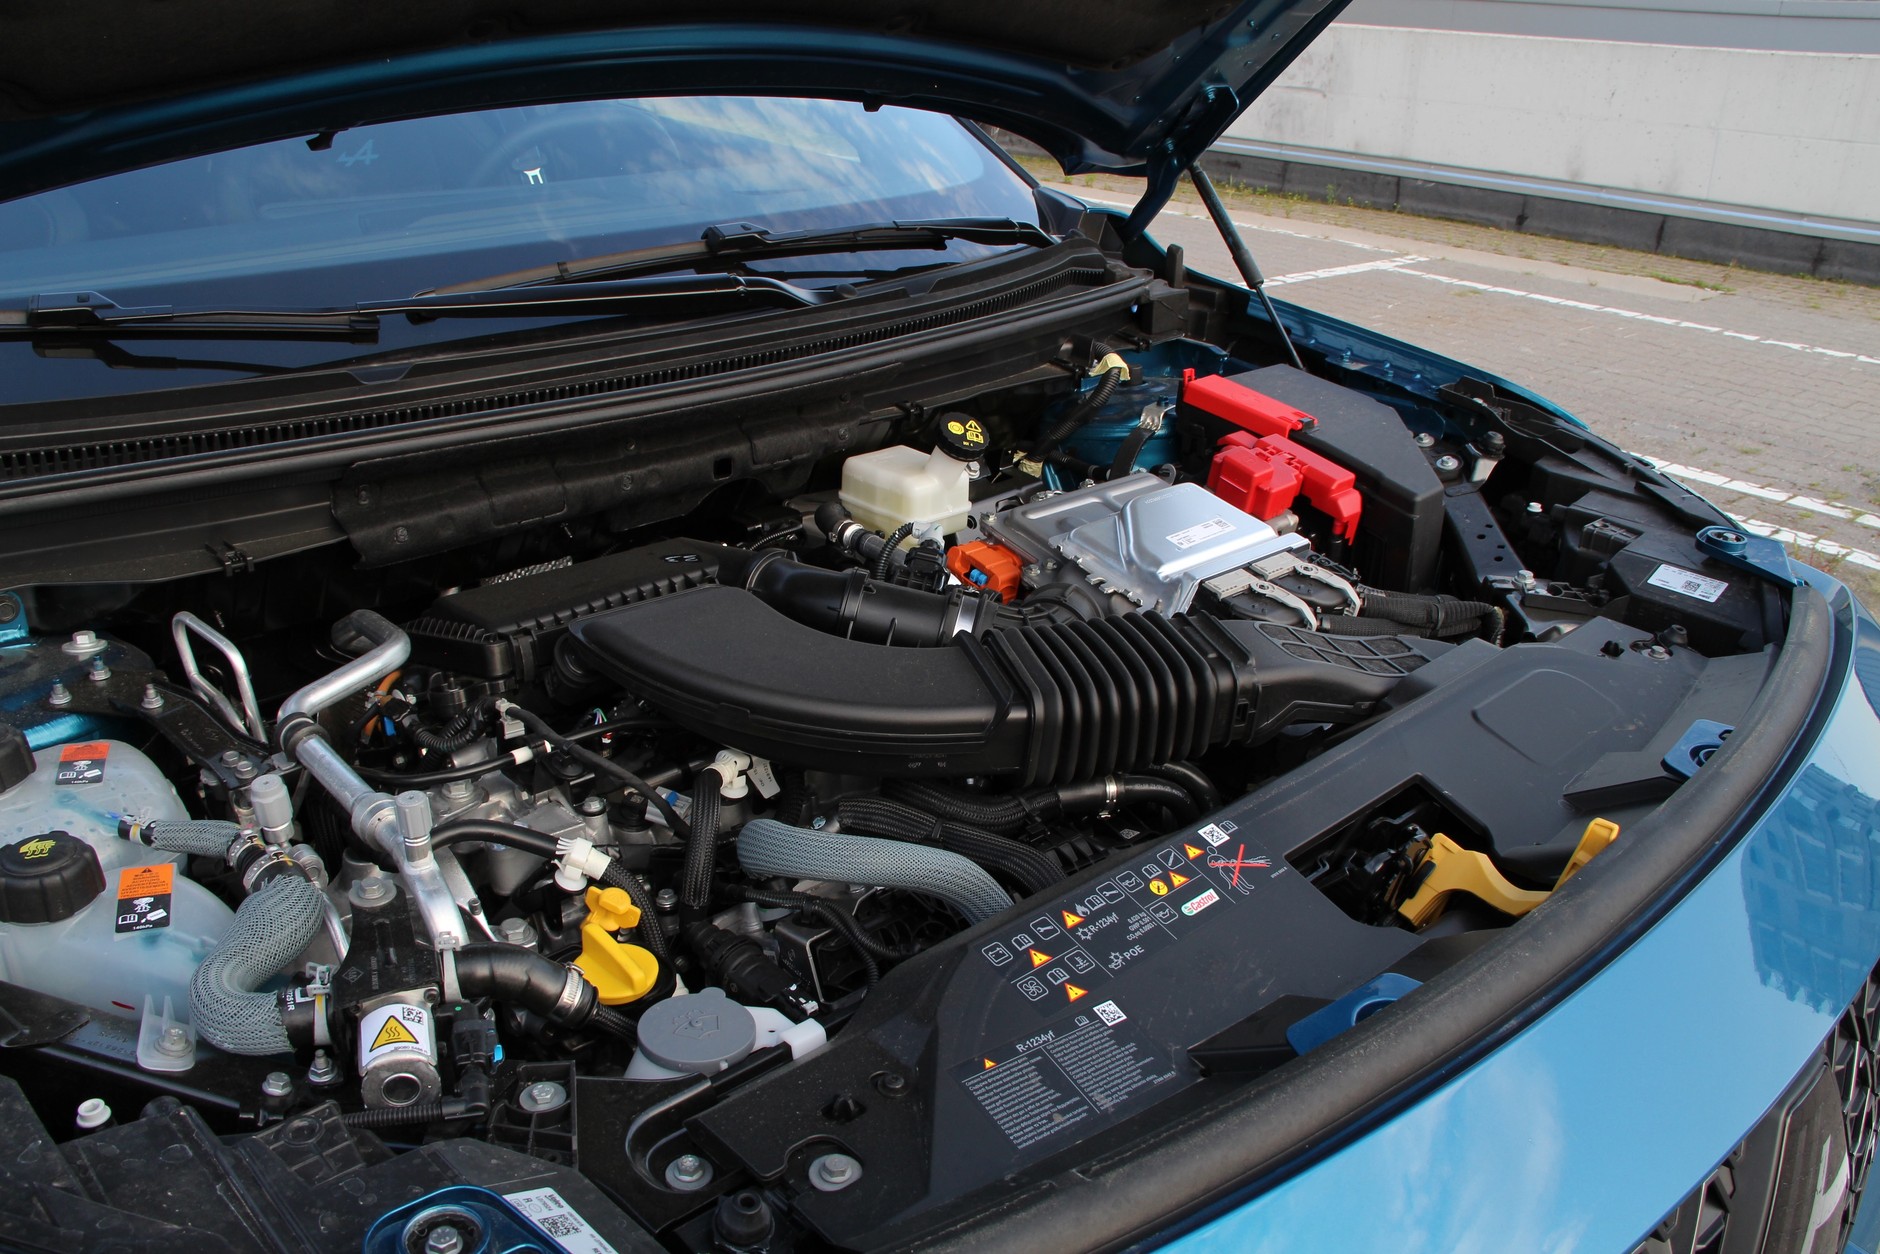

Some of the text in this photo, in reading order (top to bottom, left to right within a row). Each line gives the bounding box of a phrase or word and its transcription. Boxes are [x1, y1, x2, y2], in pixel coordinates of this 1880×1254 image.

[1190, 892, 1216, 911] Castrol
[1088, 912, 1119, 933] R-1234yf
[1129, 921, 1140, 931] GWP
[1123, 945, 1144, 960] POE
[1016, 1030, 1055, 1052] R-1234yf
